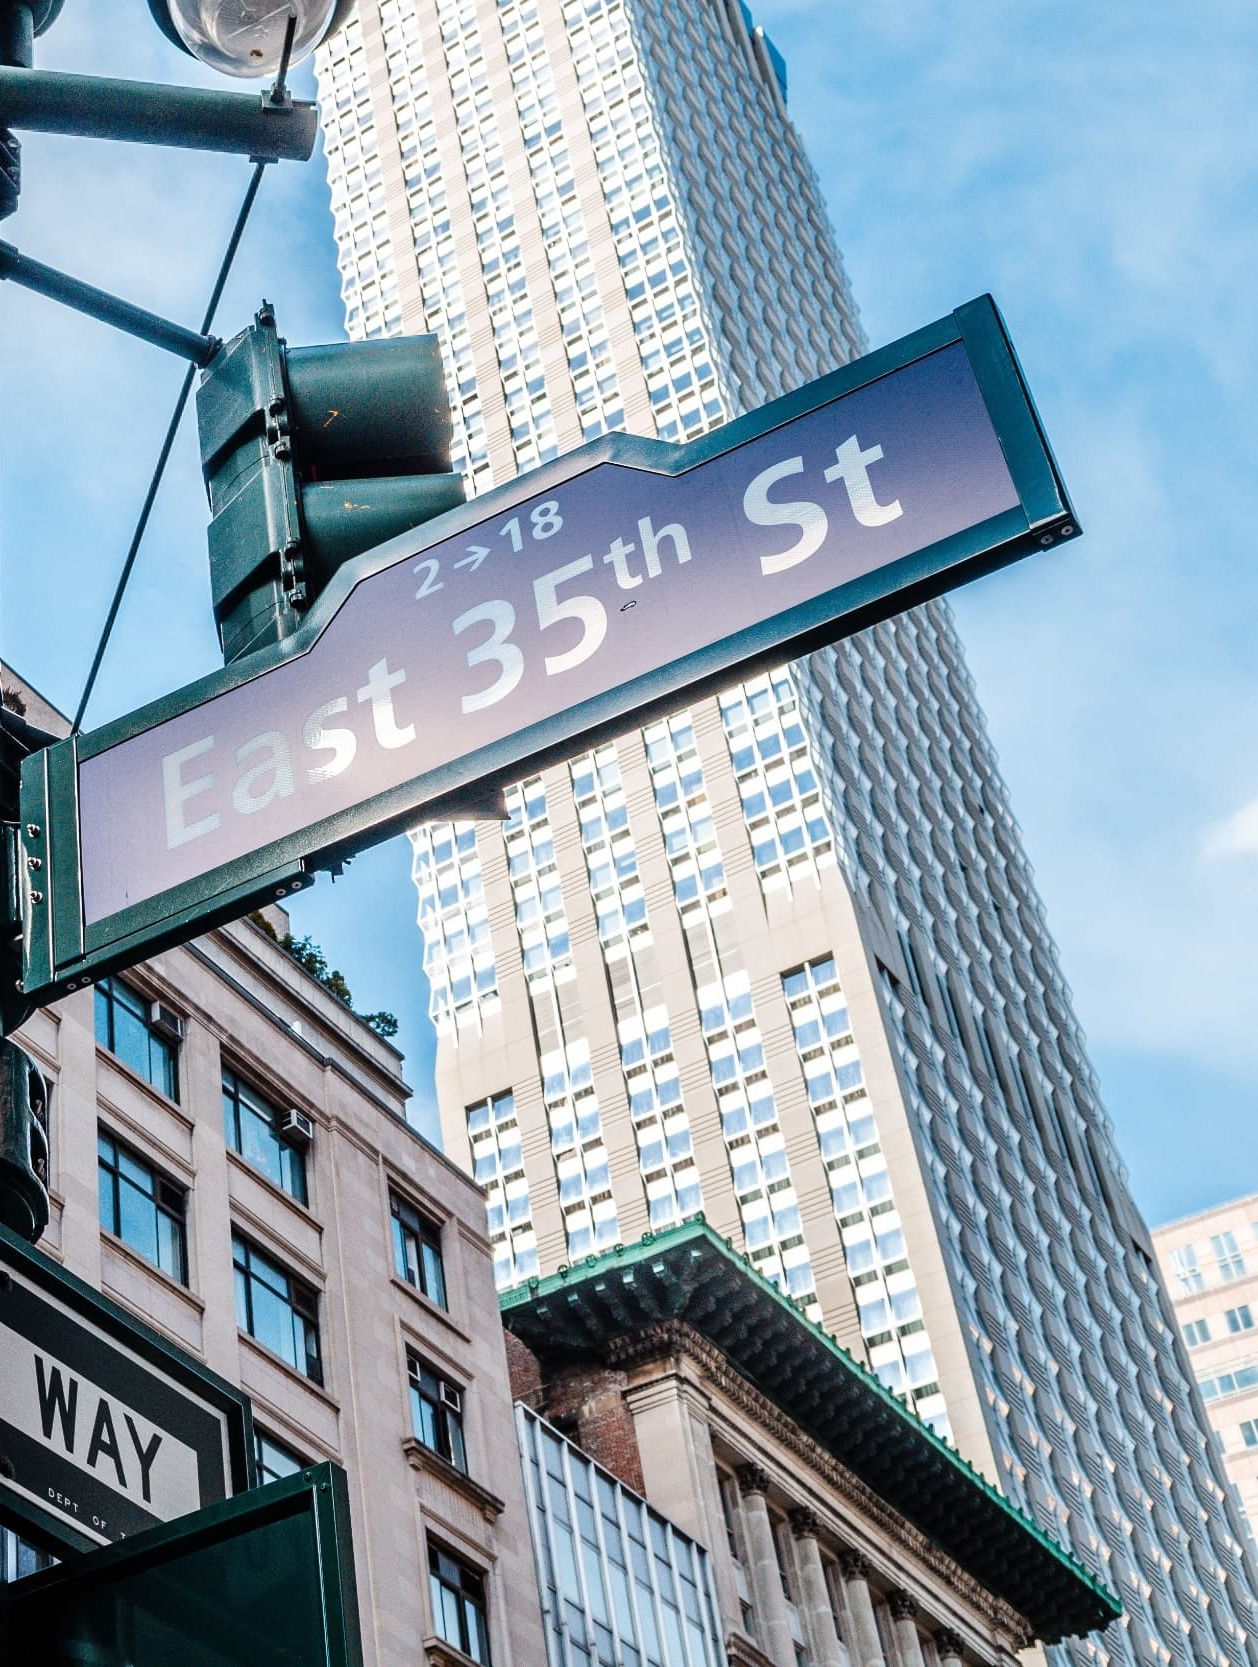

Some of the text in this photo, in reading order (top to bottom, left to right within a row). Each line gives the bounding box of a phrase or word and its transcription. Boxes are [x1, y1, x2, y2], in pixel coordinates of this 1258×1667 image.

[413, 499, 564, 600] 2 18
[159, 433, 904, 852] East 35th St
[34, 1353, 163, 1504] WAY
[47, 1487, 108, 1530] DEPT OF
